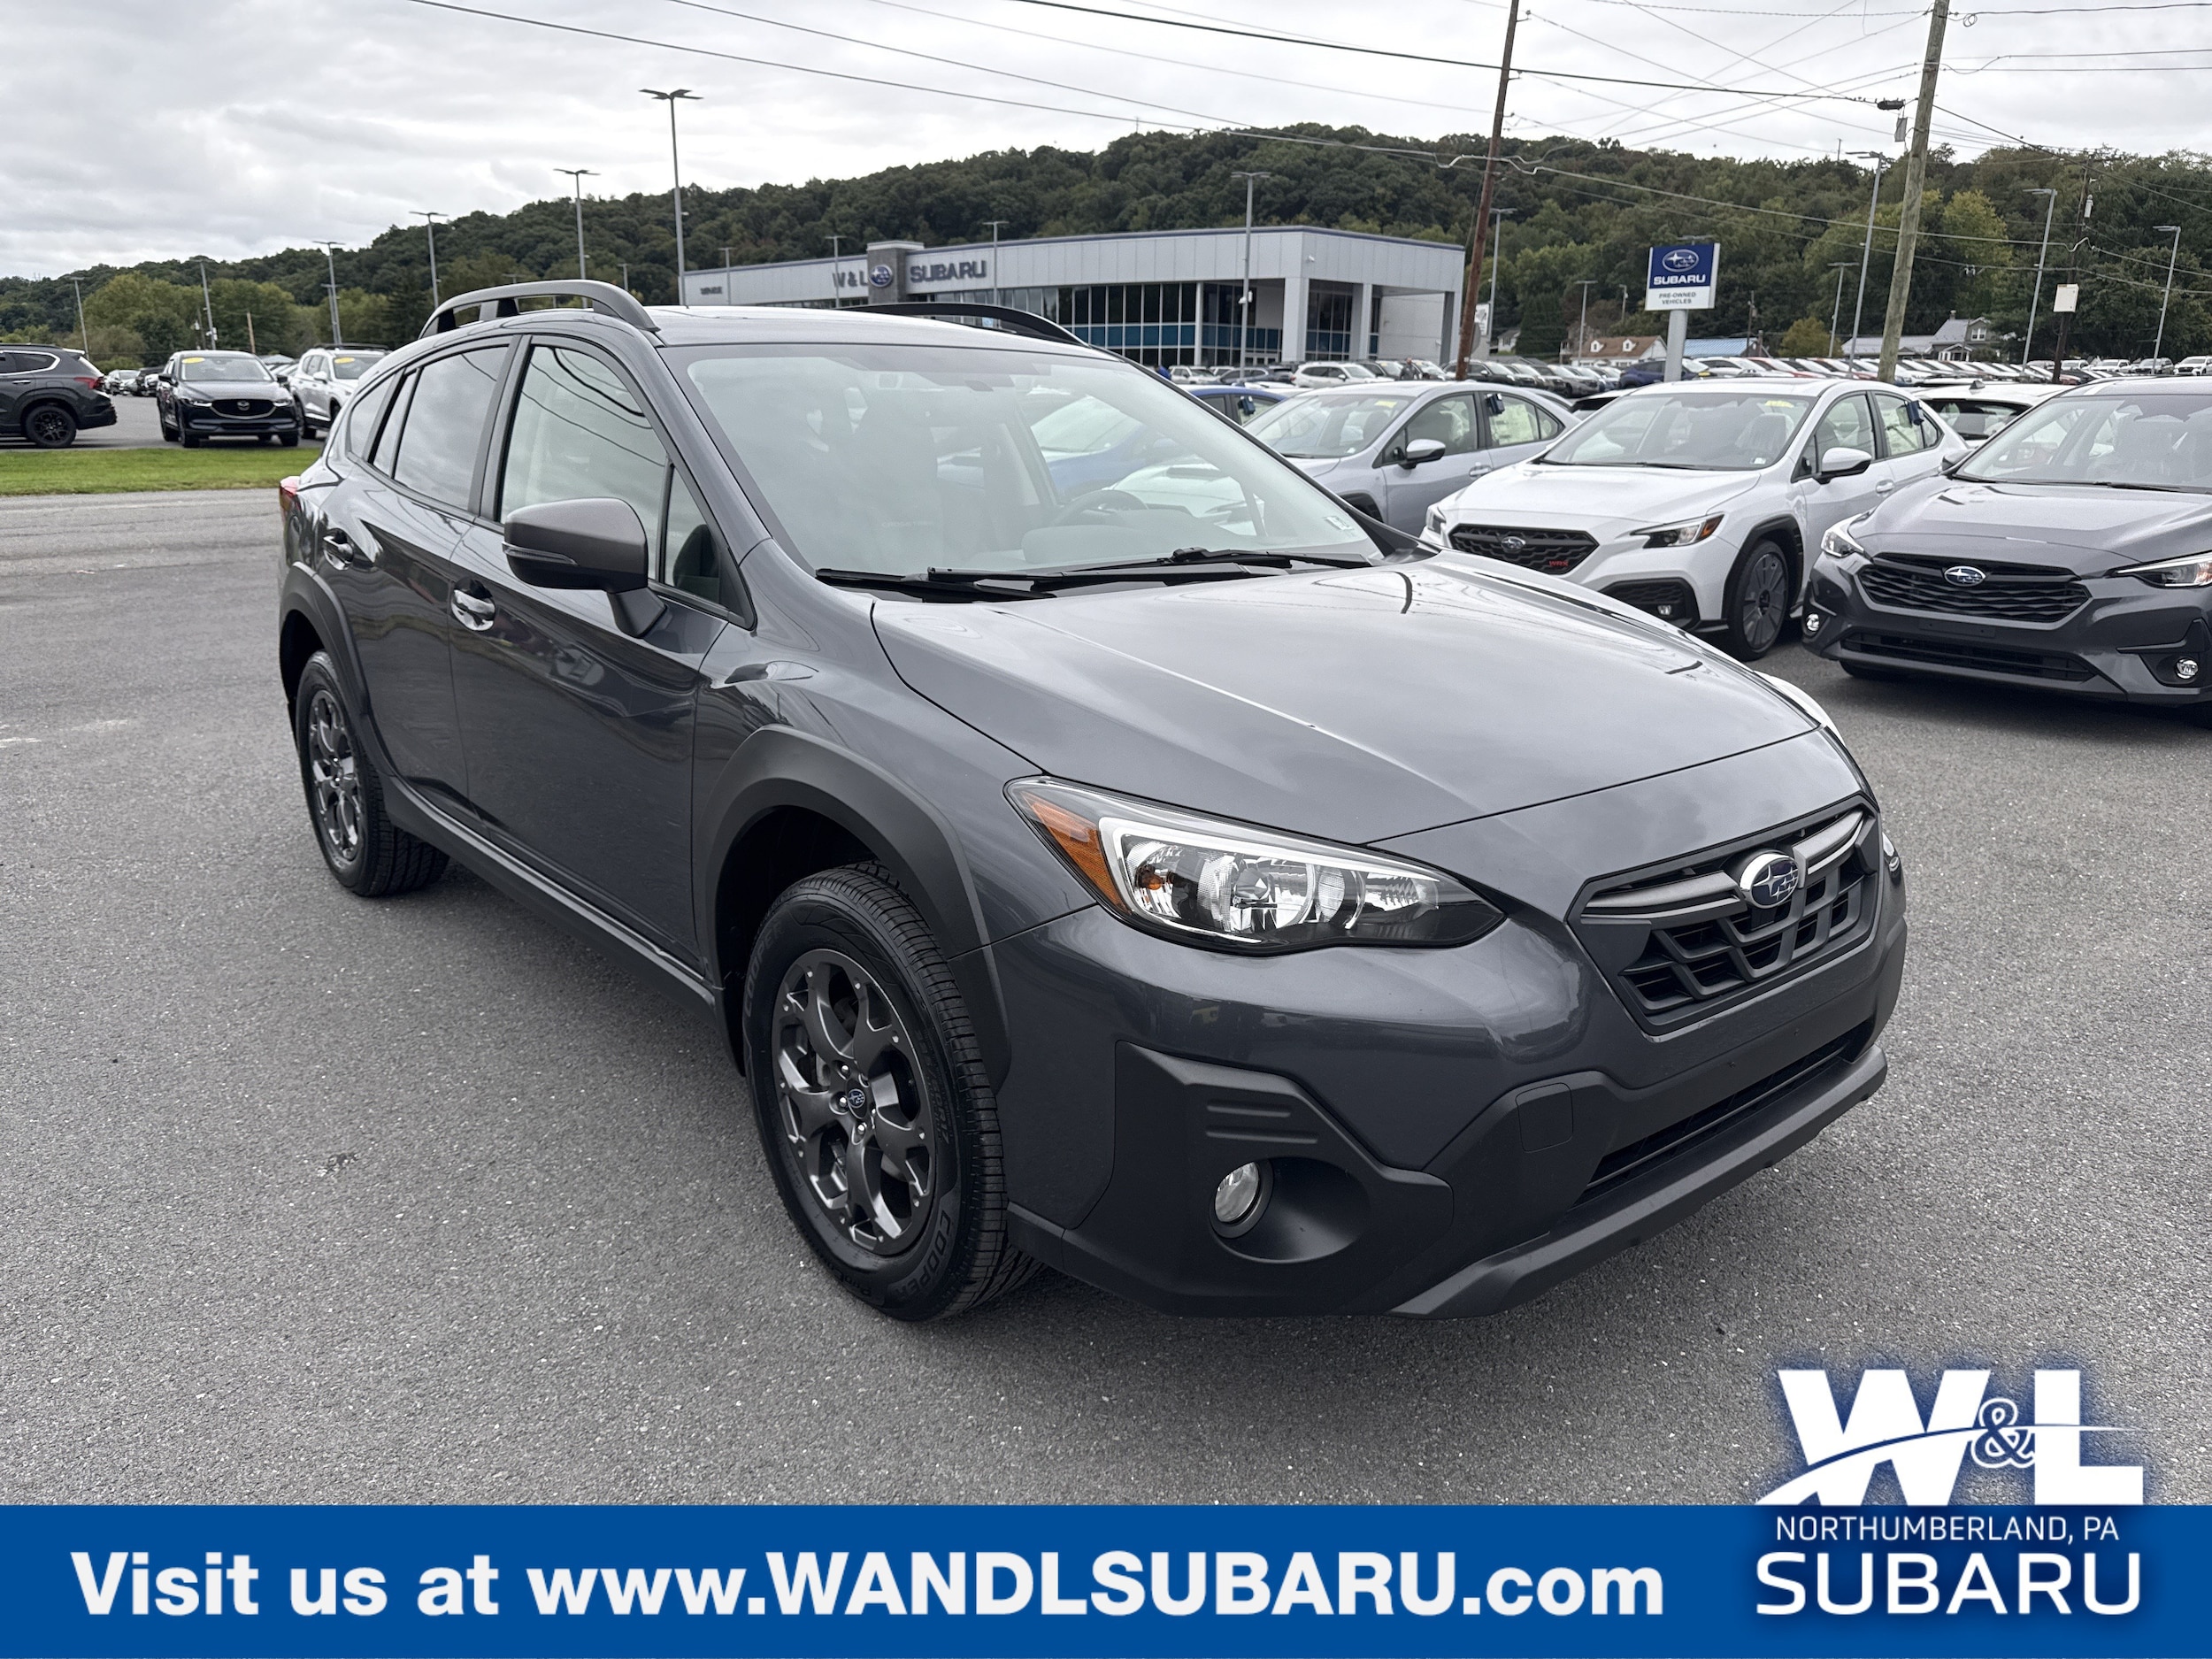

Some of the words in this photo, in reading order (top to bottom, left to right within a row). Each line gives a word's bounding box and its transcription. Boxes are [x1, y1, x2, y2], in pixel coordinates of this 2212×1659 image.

[910, 259, 987, 283] SUBARU
[1653, 273, 1706, 286] SUBARU
[894, 1209, 952, 1300] COOPER
